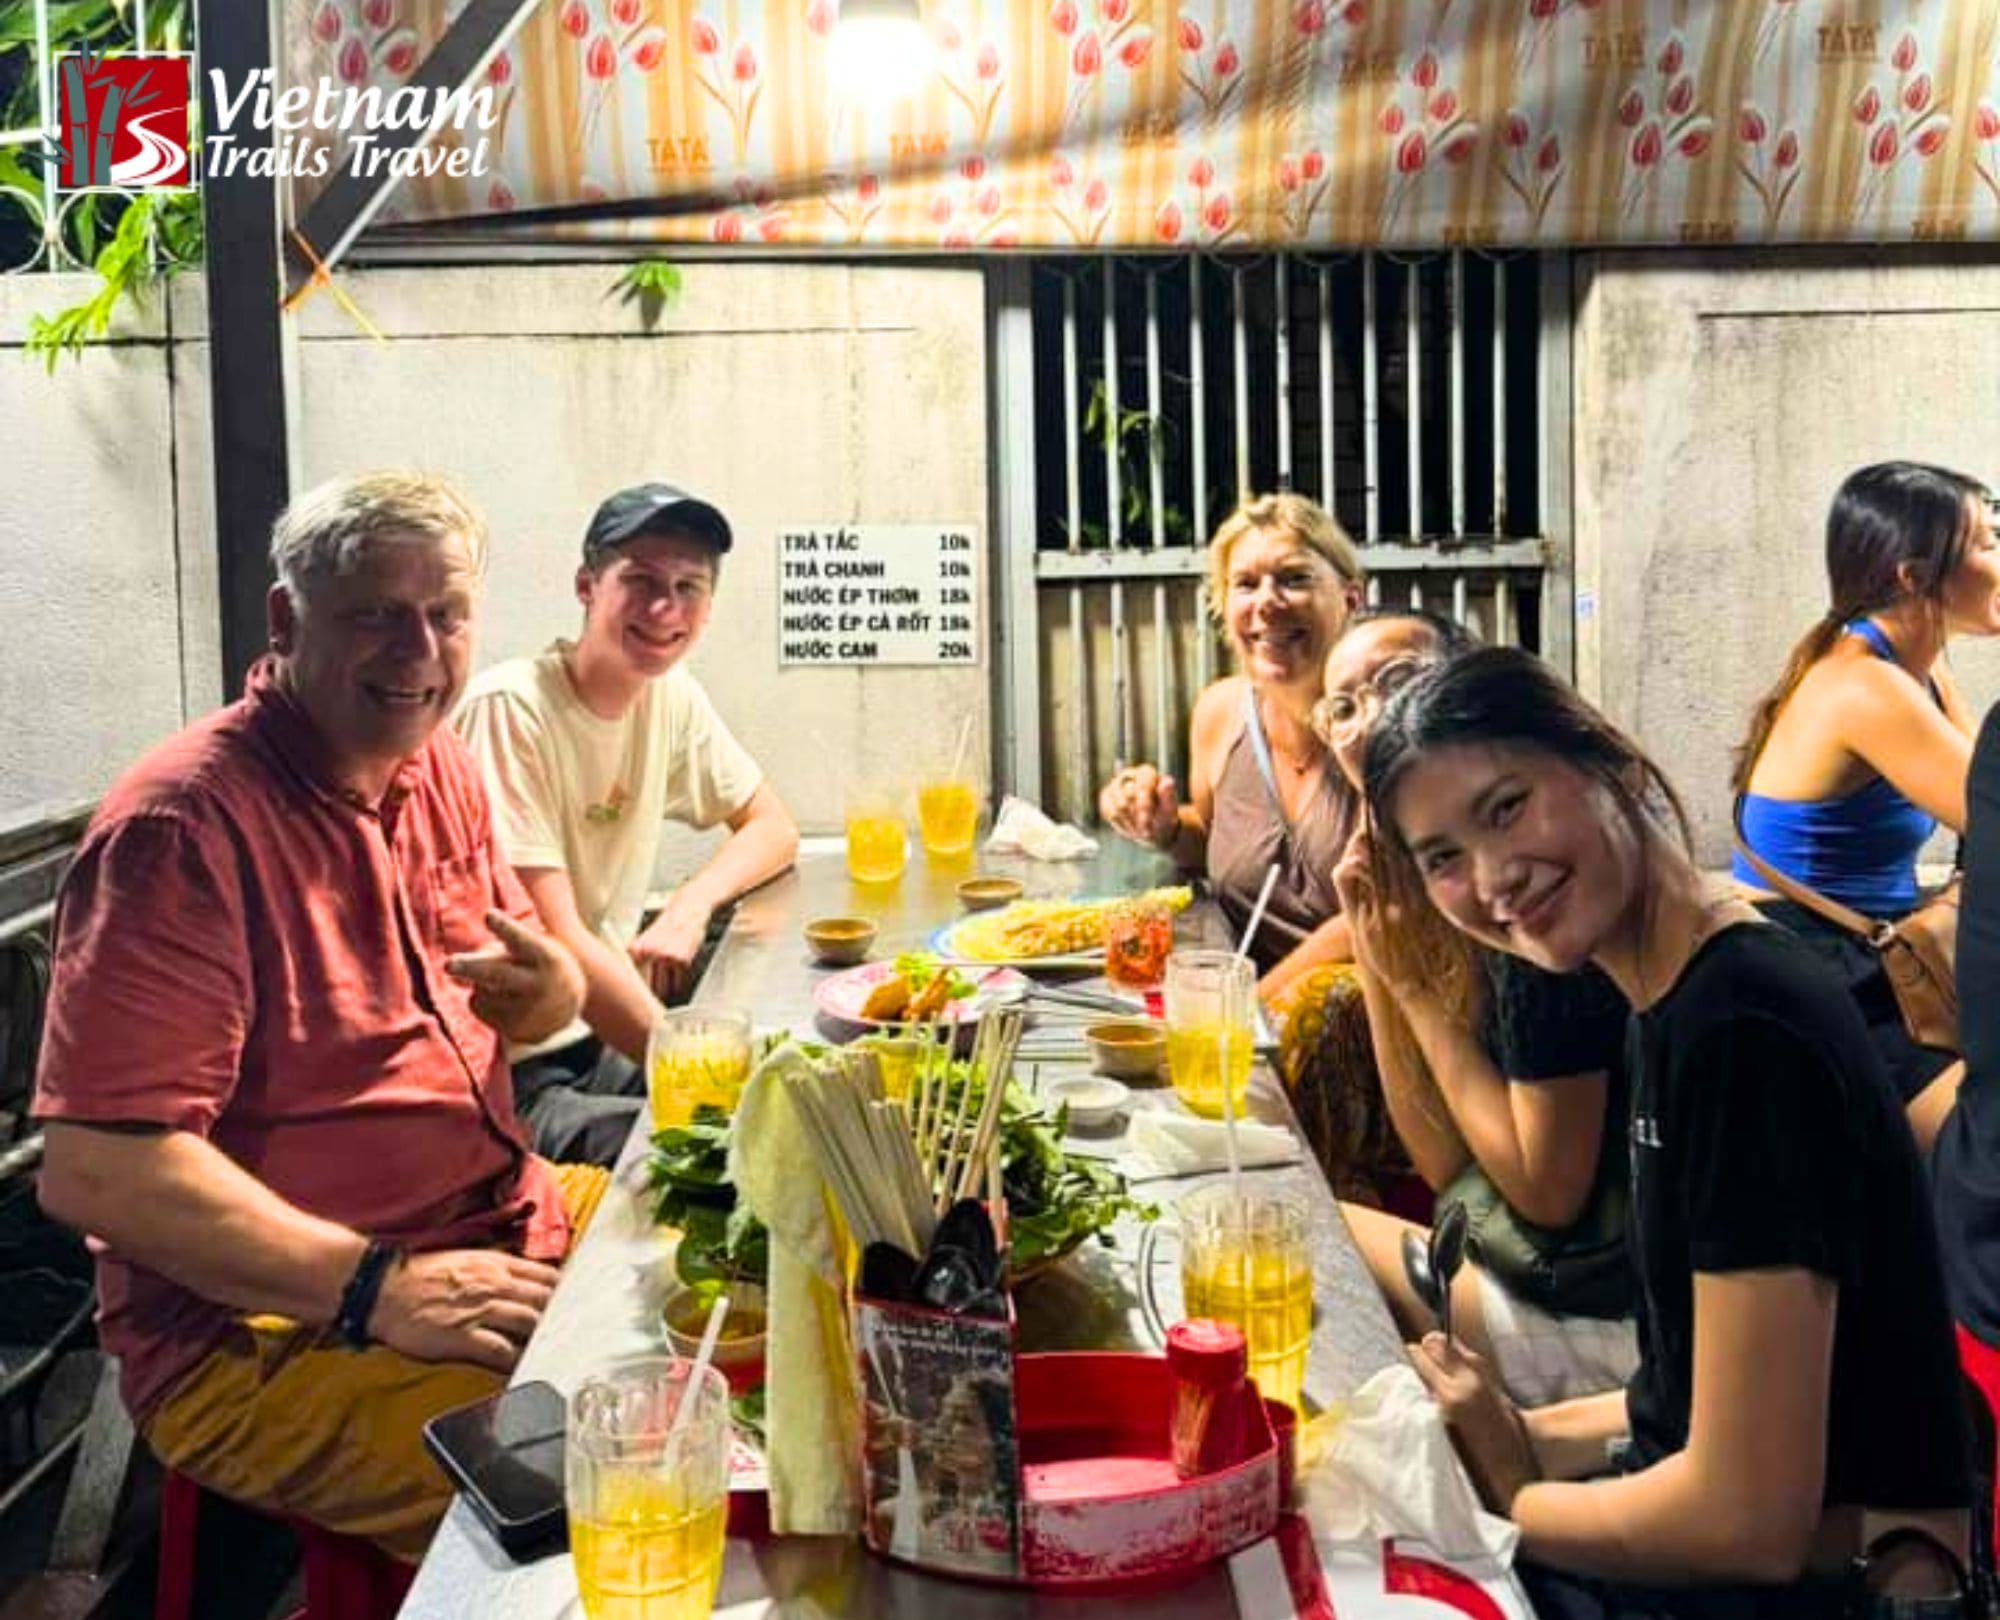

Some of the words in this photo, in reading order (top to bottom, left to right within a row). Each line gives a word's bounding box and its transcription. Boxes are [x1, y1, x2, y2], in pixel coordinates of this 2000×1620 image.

[646, 137, 709, 165] TATA
[784, 531, 818, 551] TRÀ
[784, 560, 818, 577] TRÀ
[824, 561, 885, 577] CHANH
[839, 584, 863, 604] ÉP
[839, 612, 863, 631] ÉP
[838, 642, 879, 658] CAM
